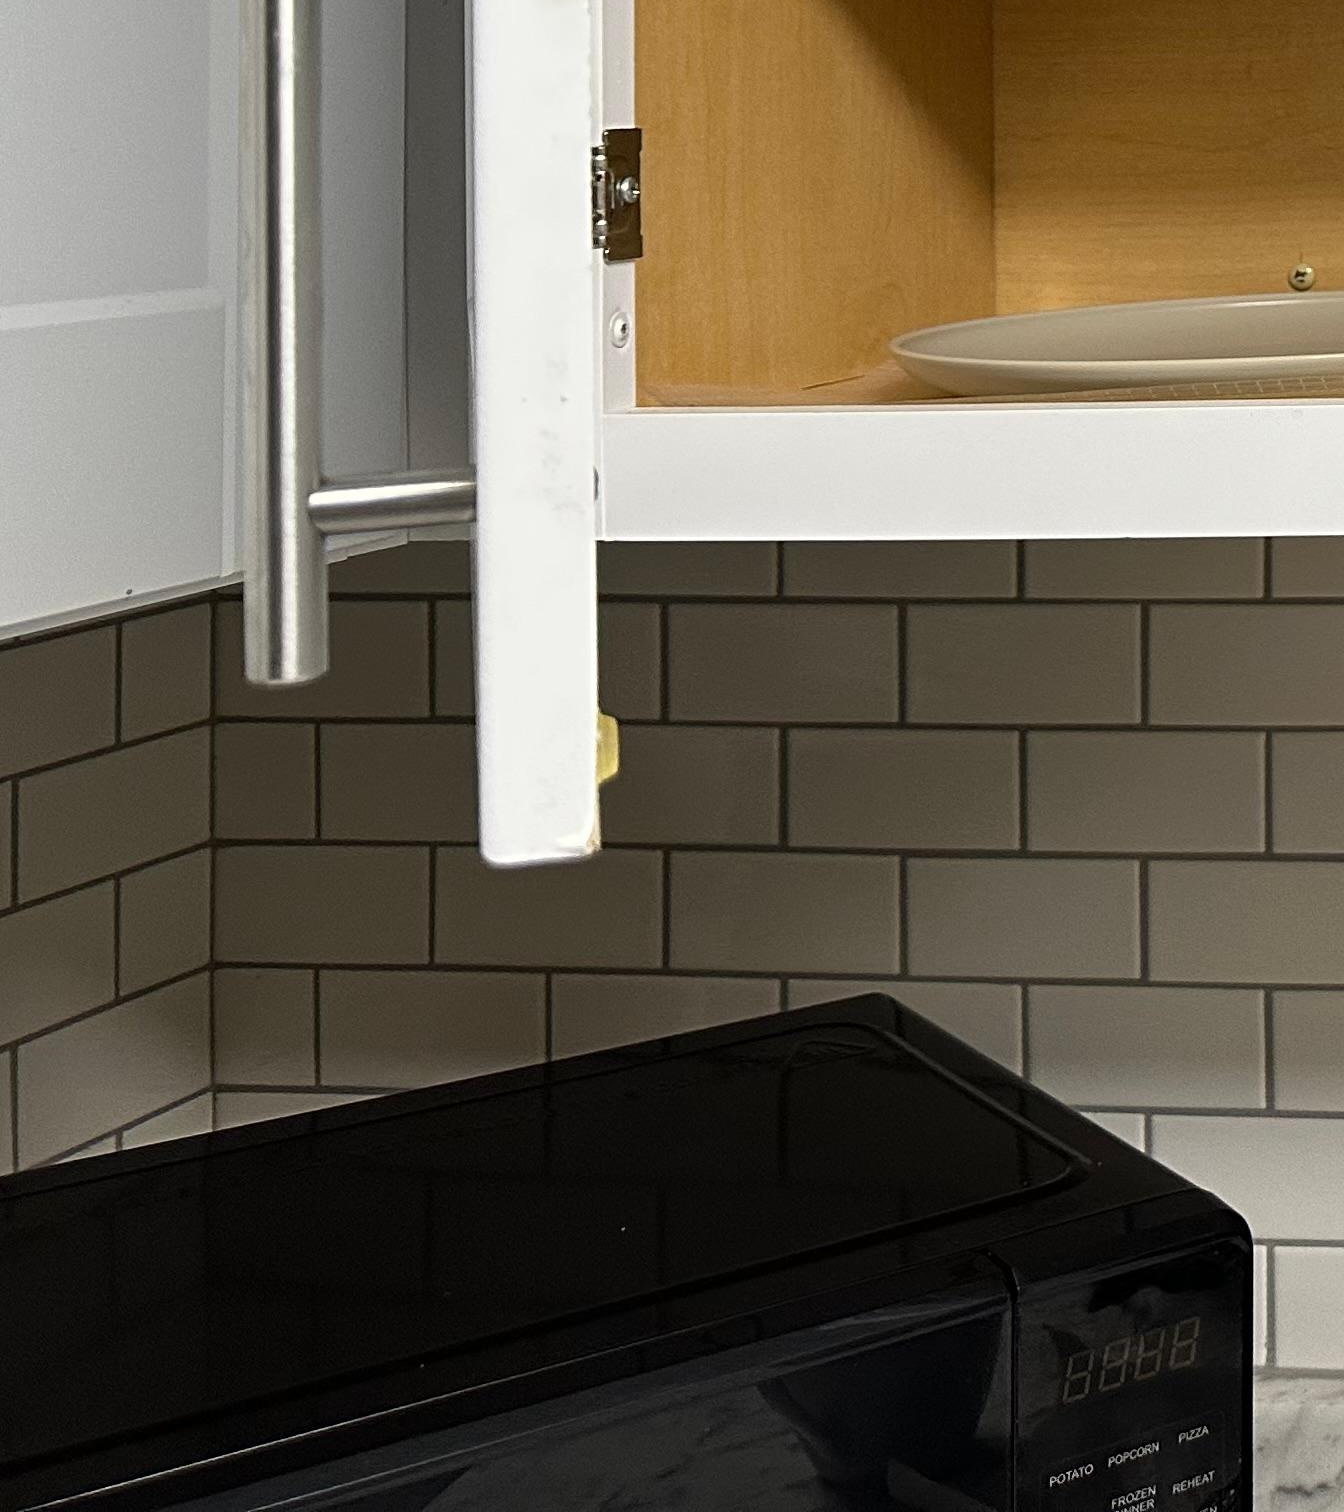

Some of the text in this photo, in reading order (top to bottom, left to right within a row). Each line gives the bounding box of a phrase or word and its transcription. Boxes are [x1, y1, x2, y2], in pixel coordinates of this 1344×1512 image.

[1049, 1425, 1209, 1487] POTATO POPCORN PIZZA
[1172, 1470, 1215, 1494] REHEAT
[1111, 1484, 1156, 1509] FROZEN
